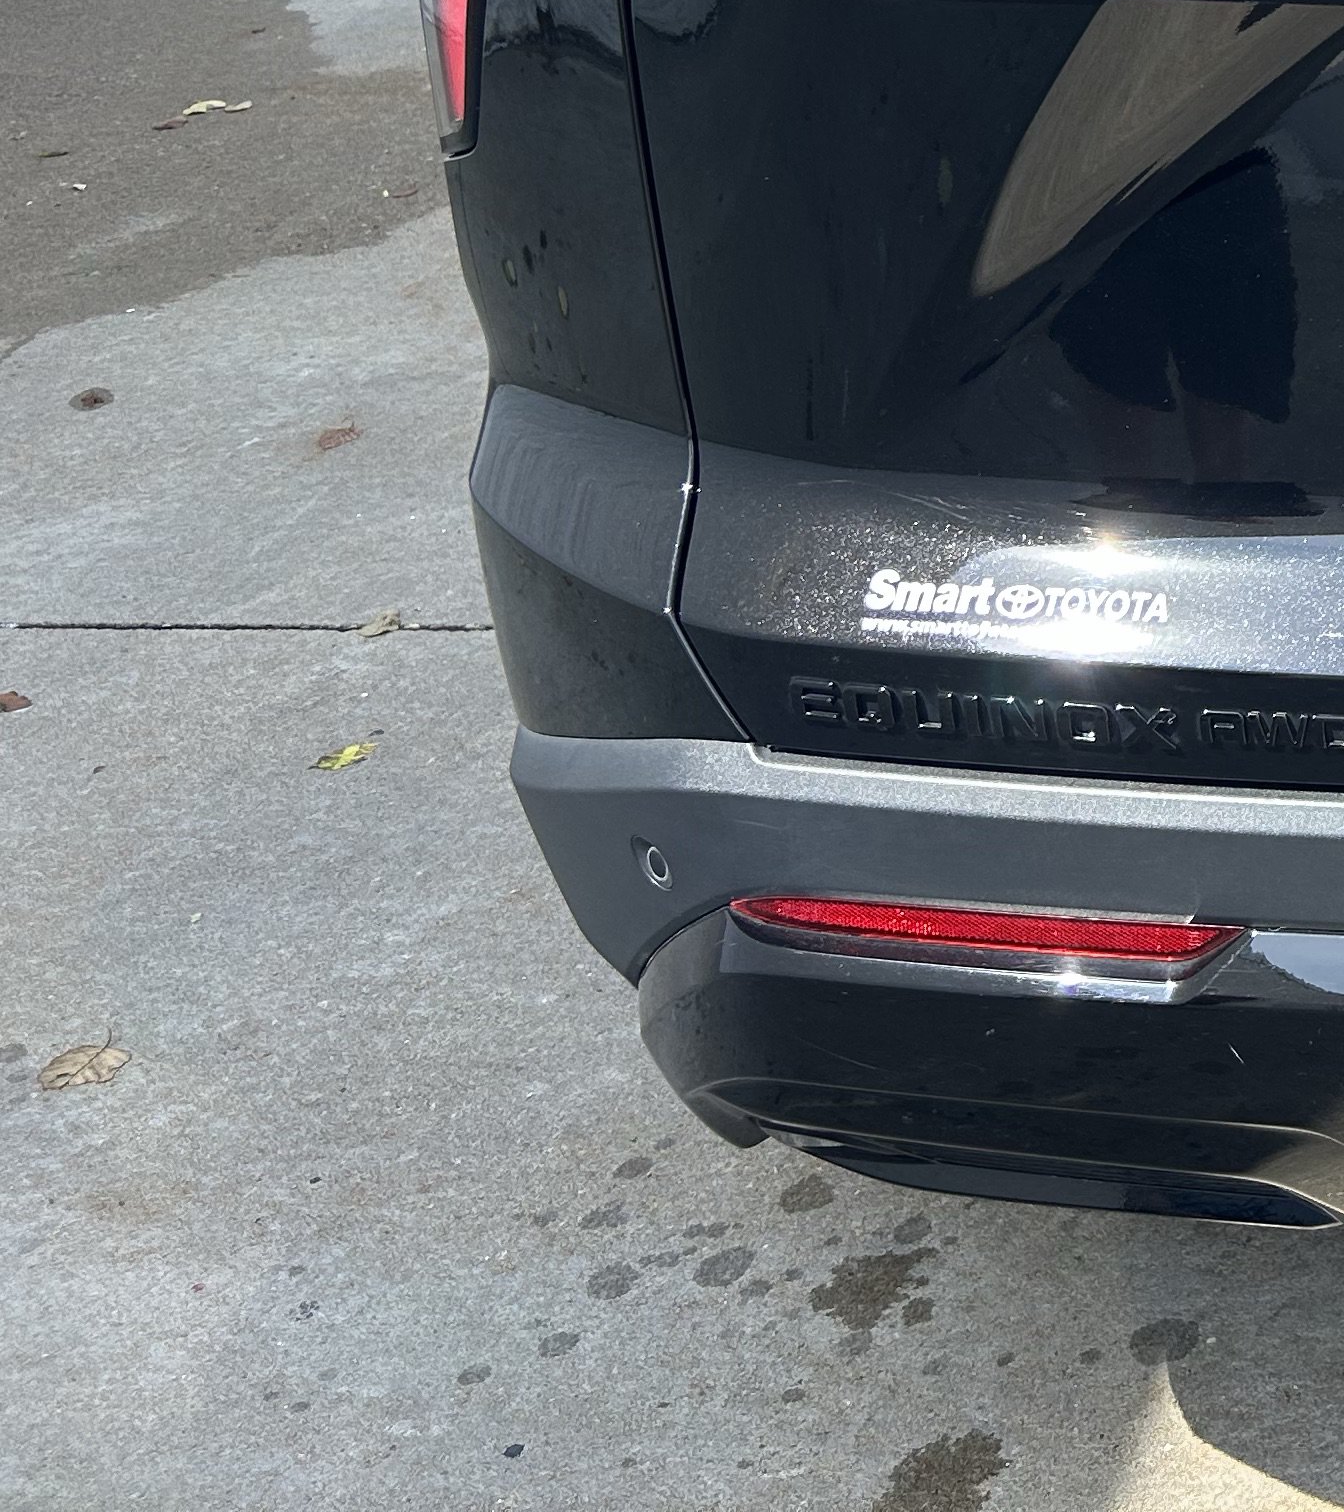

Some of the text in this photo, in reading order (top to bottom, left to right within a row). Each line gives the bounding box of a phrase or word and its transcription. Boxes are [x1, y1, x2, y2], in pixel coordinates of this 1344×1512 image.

[864, 568, 1169, 623] Smart TOYOTA
[792, 675, 1181, 751] EQUINOX
